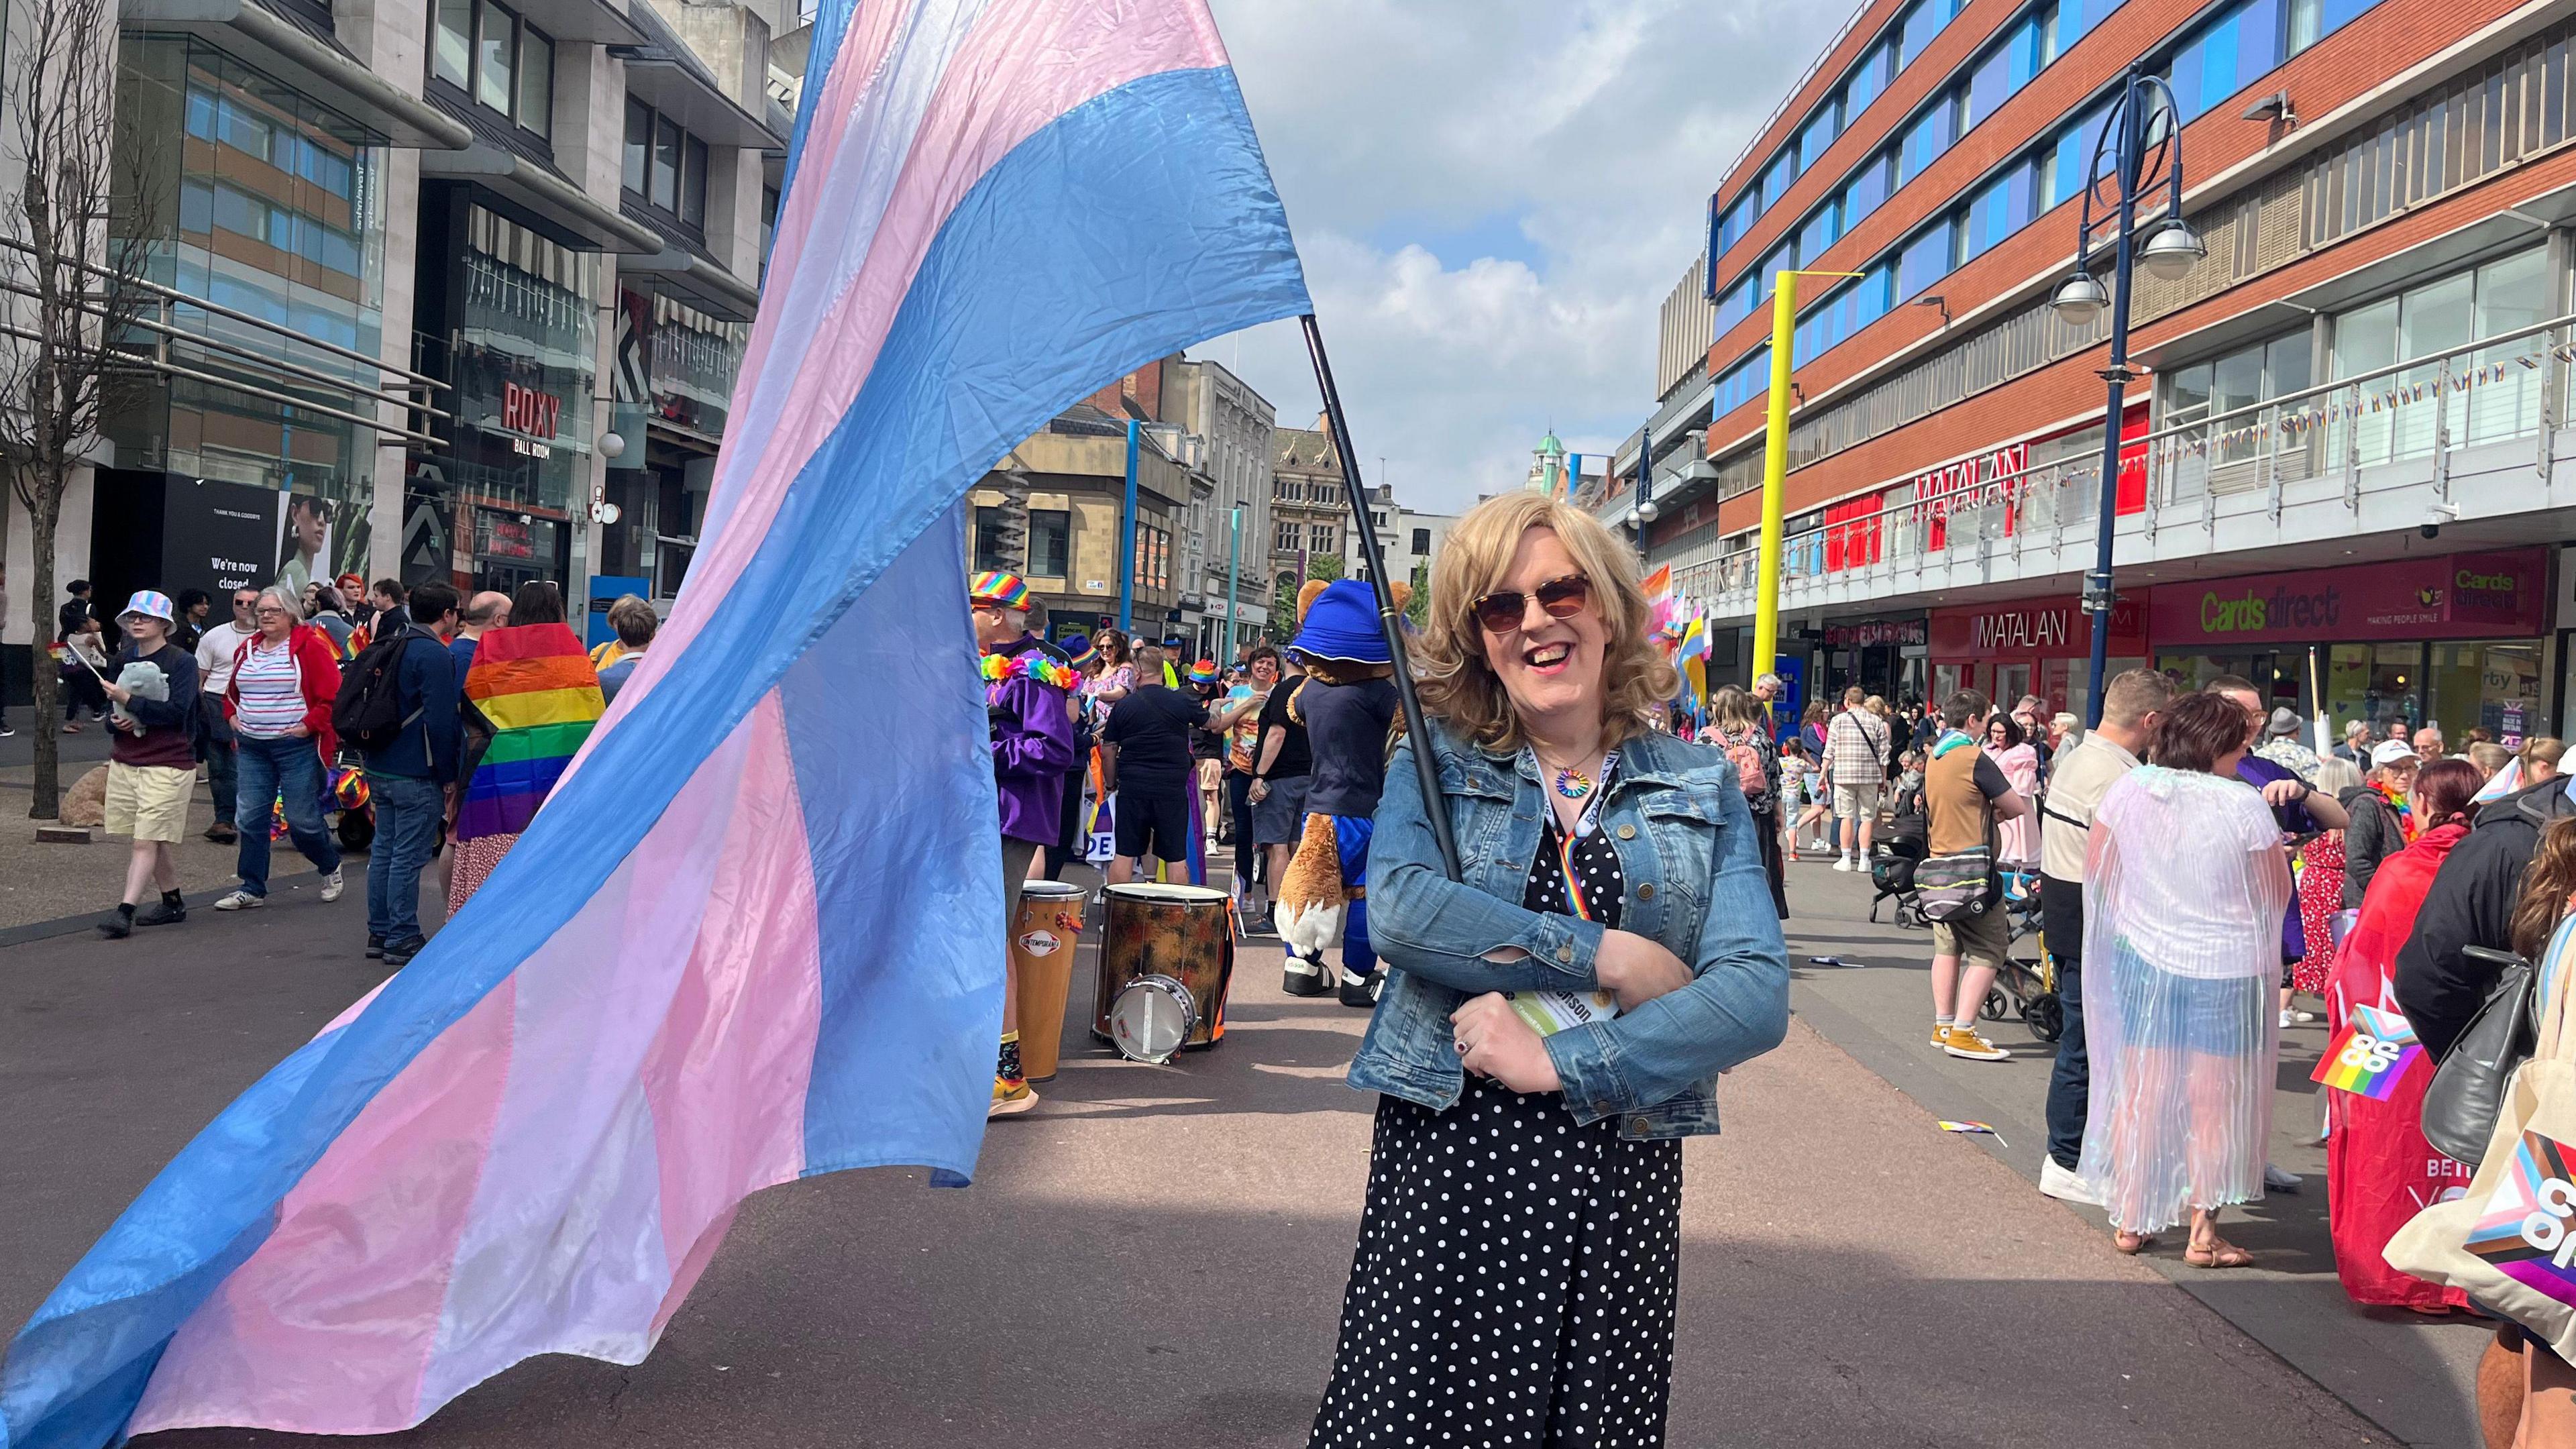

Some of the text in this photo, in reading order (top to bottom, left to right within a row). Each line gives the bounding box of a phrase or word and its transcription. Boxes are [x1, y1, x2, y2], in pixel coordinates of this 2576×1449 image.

[502, 380, 560, 440] ROXY
[514, 438, 549, 460] BALL ROOM
[1911, 443, 2030, 519] MATALAN
[213, 508, 228, 516] THANK
[241, 512, 261, 521] GOODBYE
[211, 557, 258, 573] We're now
[2455, 570, 2514, 590] Cards
[1978, 609, 2066, 647] MATALAN
[2367, 613, 2438, 625] MAKING PEOPLE SMILE
